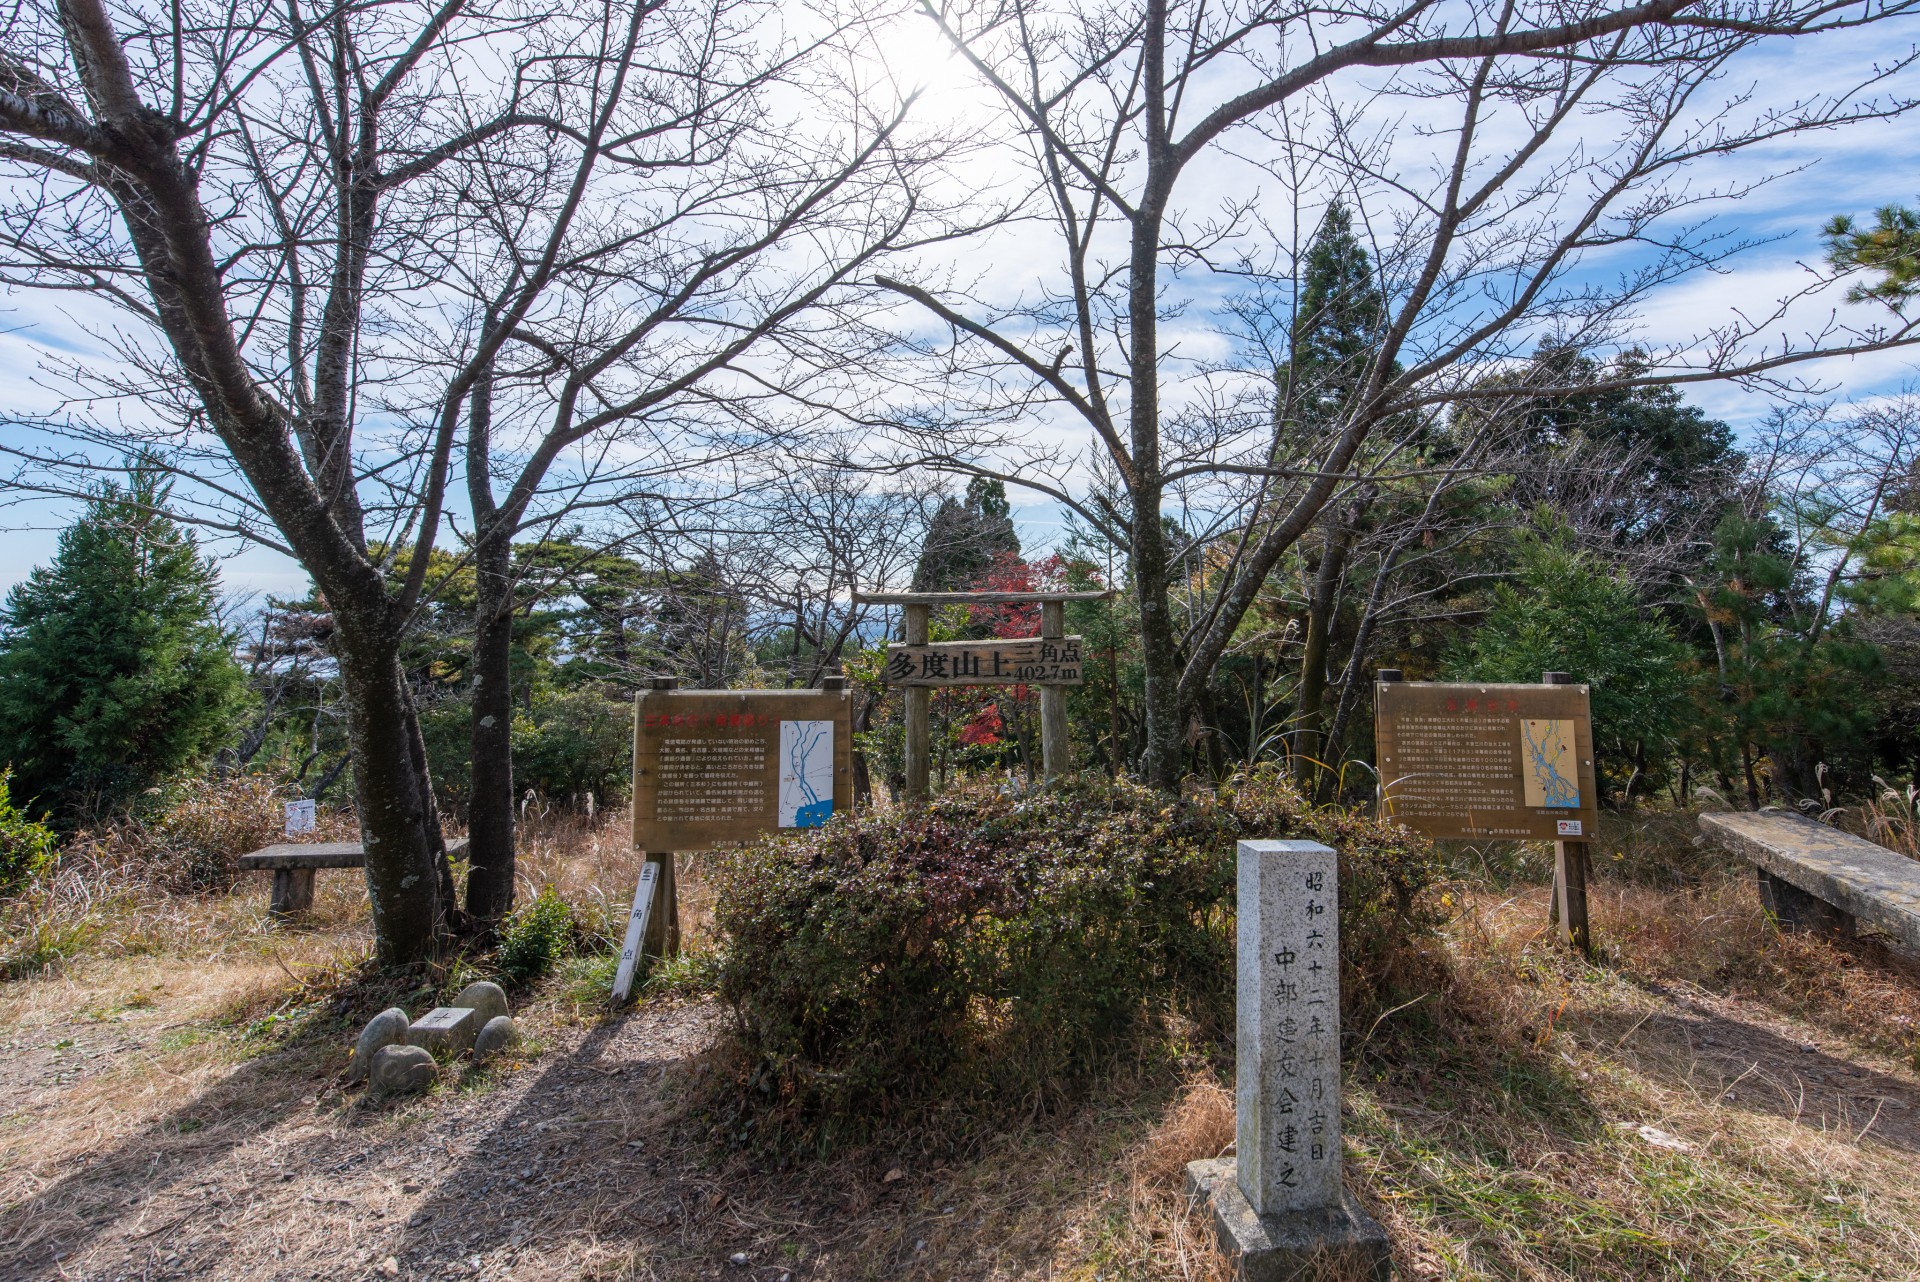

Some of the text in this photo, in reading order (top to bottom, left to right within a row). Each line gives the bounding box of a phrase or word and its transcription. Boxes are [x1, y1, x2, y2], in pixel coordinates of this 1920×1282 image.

[888, 651, 1011, 680] 多度山上
[1014, 642, 1080, 665] 三角点
[1013, 665, 1078, 682] 402.7m
[622, 868, 652, 960] 三角点
[1305, 872, 1326, 1161] 昭和六十二年十月吉日
